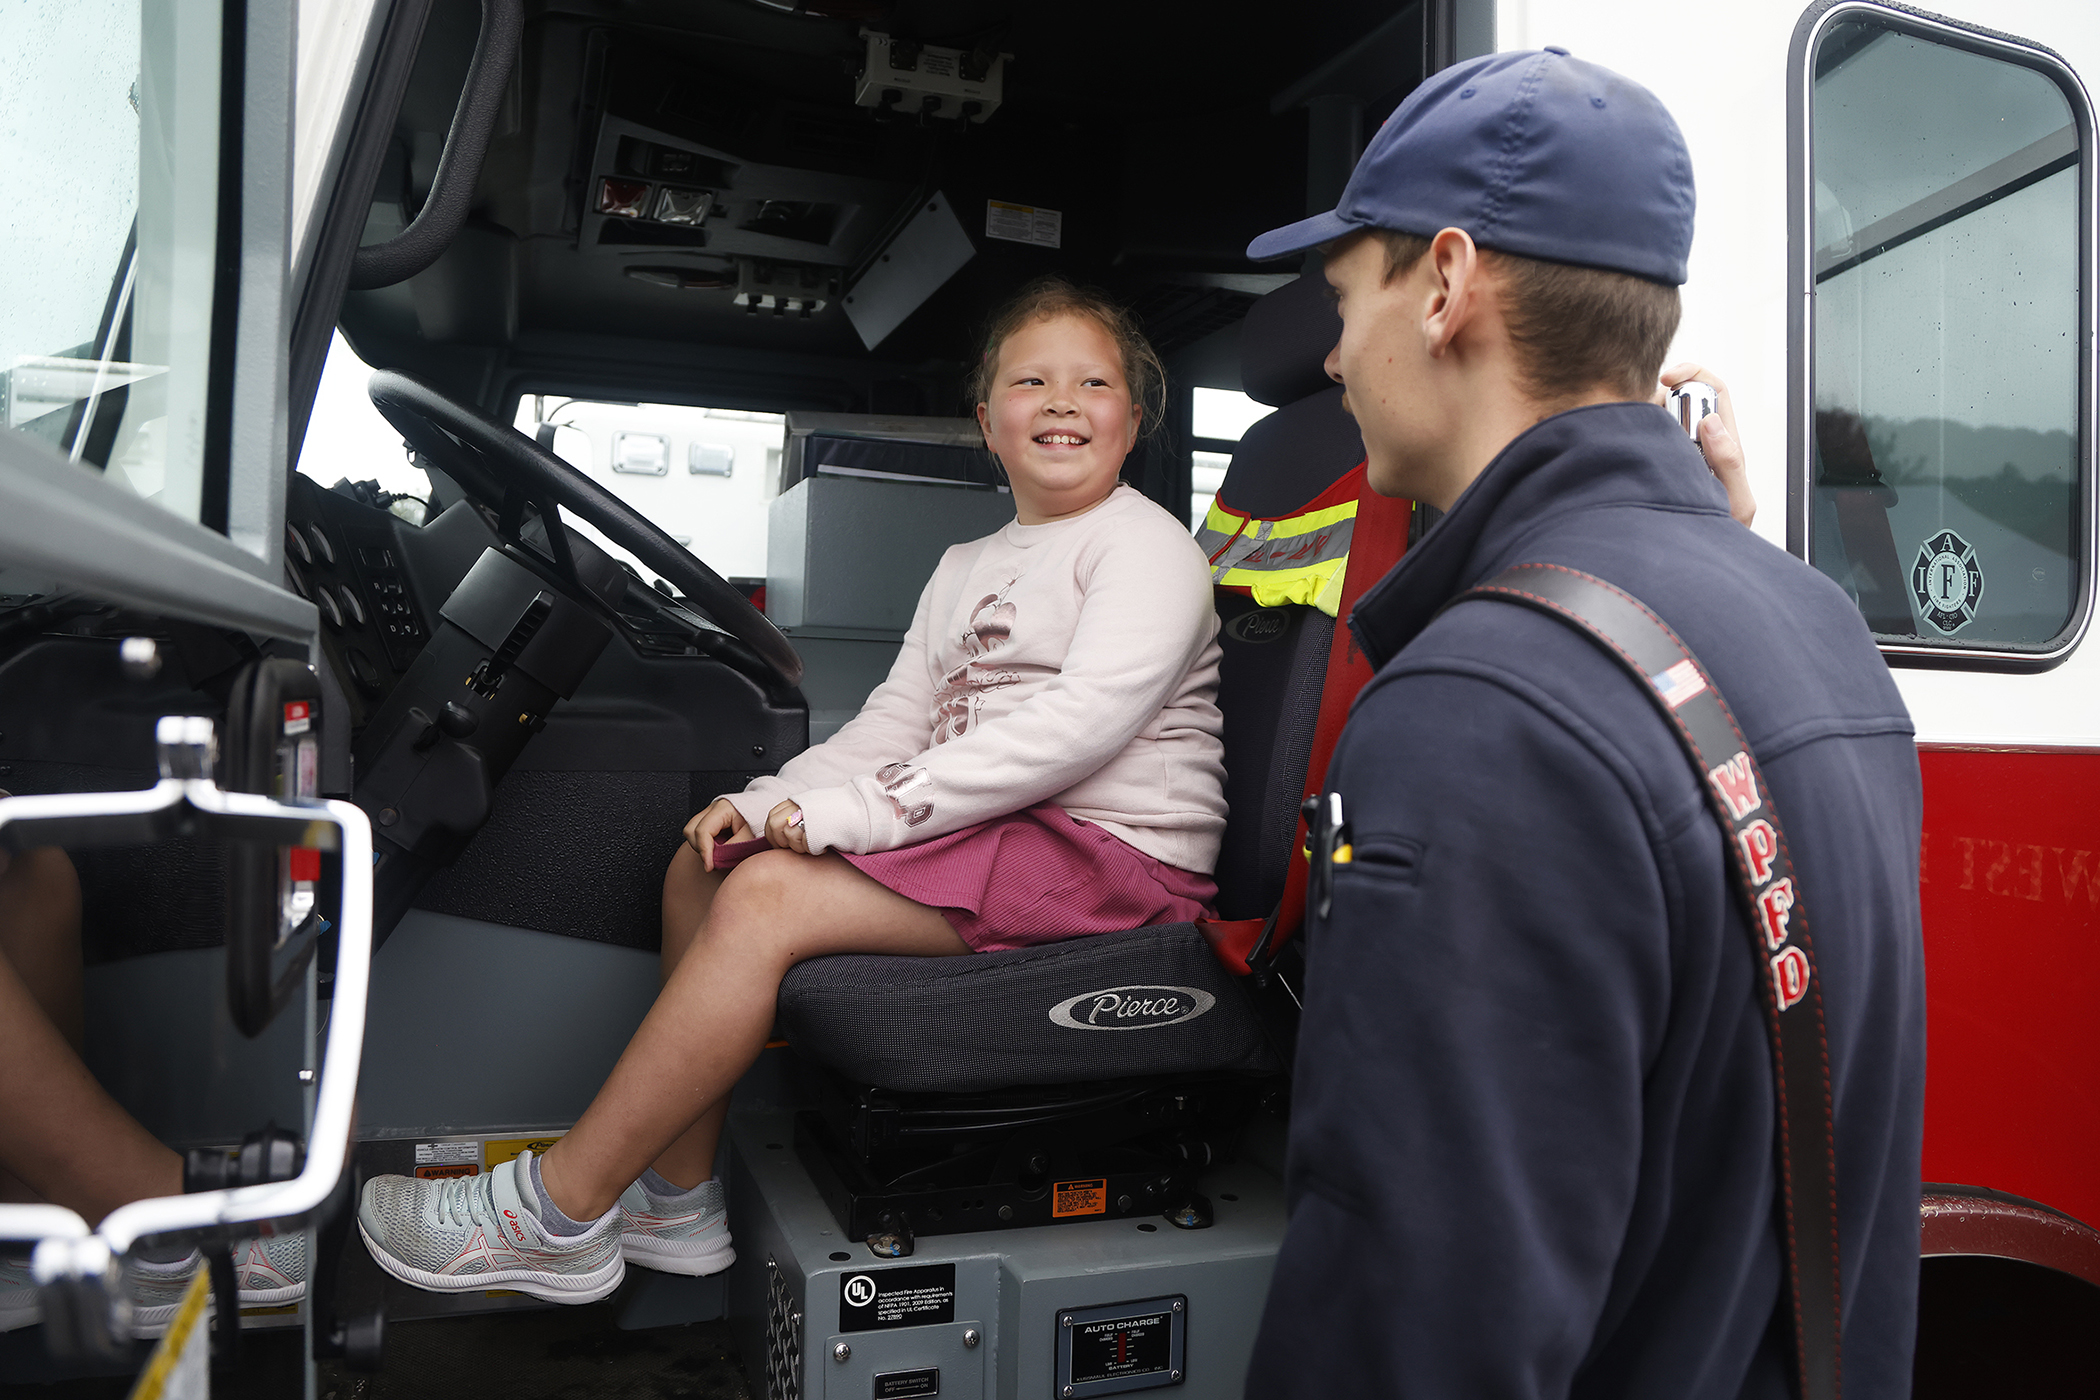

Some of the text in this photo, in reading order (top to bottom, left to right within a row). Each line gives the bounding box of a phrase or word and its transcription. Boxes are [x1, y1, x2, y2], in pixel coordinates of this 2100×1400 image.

[1940, 534, 1956, 553] A
[1708, 750, 1811, 1012] WPFD
[1088, 993, 1180, 1024] Pierce
[431, 1168, 471, 1177] WARNING
[852, 1282, 868, 1300] UL
[877, 1296, 910, 1304] accordance
[921, 1291, 953, 1300] requirements
[913, 1287, 939, 1295] Apparatus
[1084, 1317, 1160, 1334] AUTO CHARGE
[884, 1377, 929, 1387] BATTERY SWITCH
